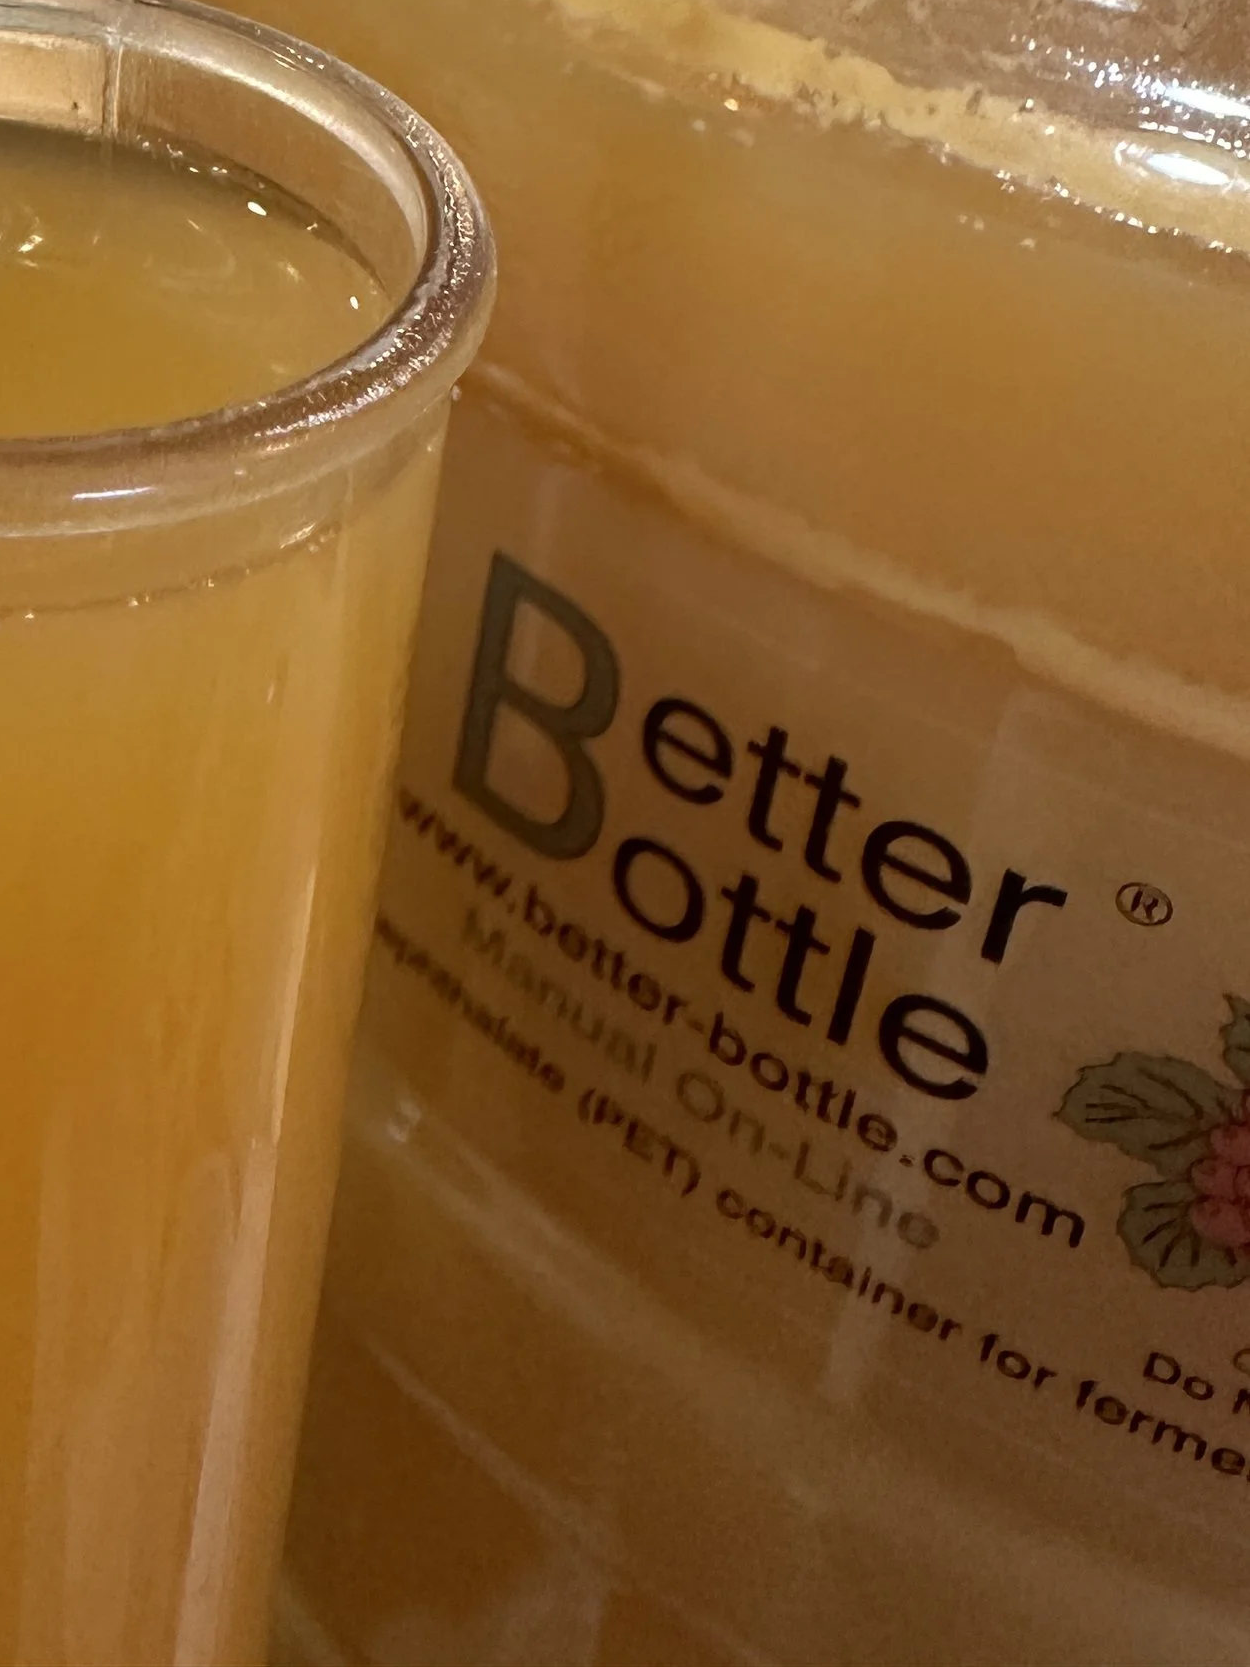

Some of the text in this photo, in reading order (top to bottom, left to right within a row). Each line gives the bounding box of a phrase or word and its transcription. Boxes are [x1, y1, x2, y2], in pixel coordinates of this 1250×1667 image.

[453, 549, 1068, 964] Better
[398, 787, 1086, 1248] www.better-bottle.com
[716, 1188, 963, 1341] container
[980, 1332, 1058, 1389] for
[1075, 1380, 1250, 1486] ferme
[1143, 1351, 1214, 1401] Do
